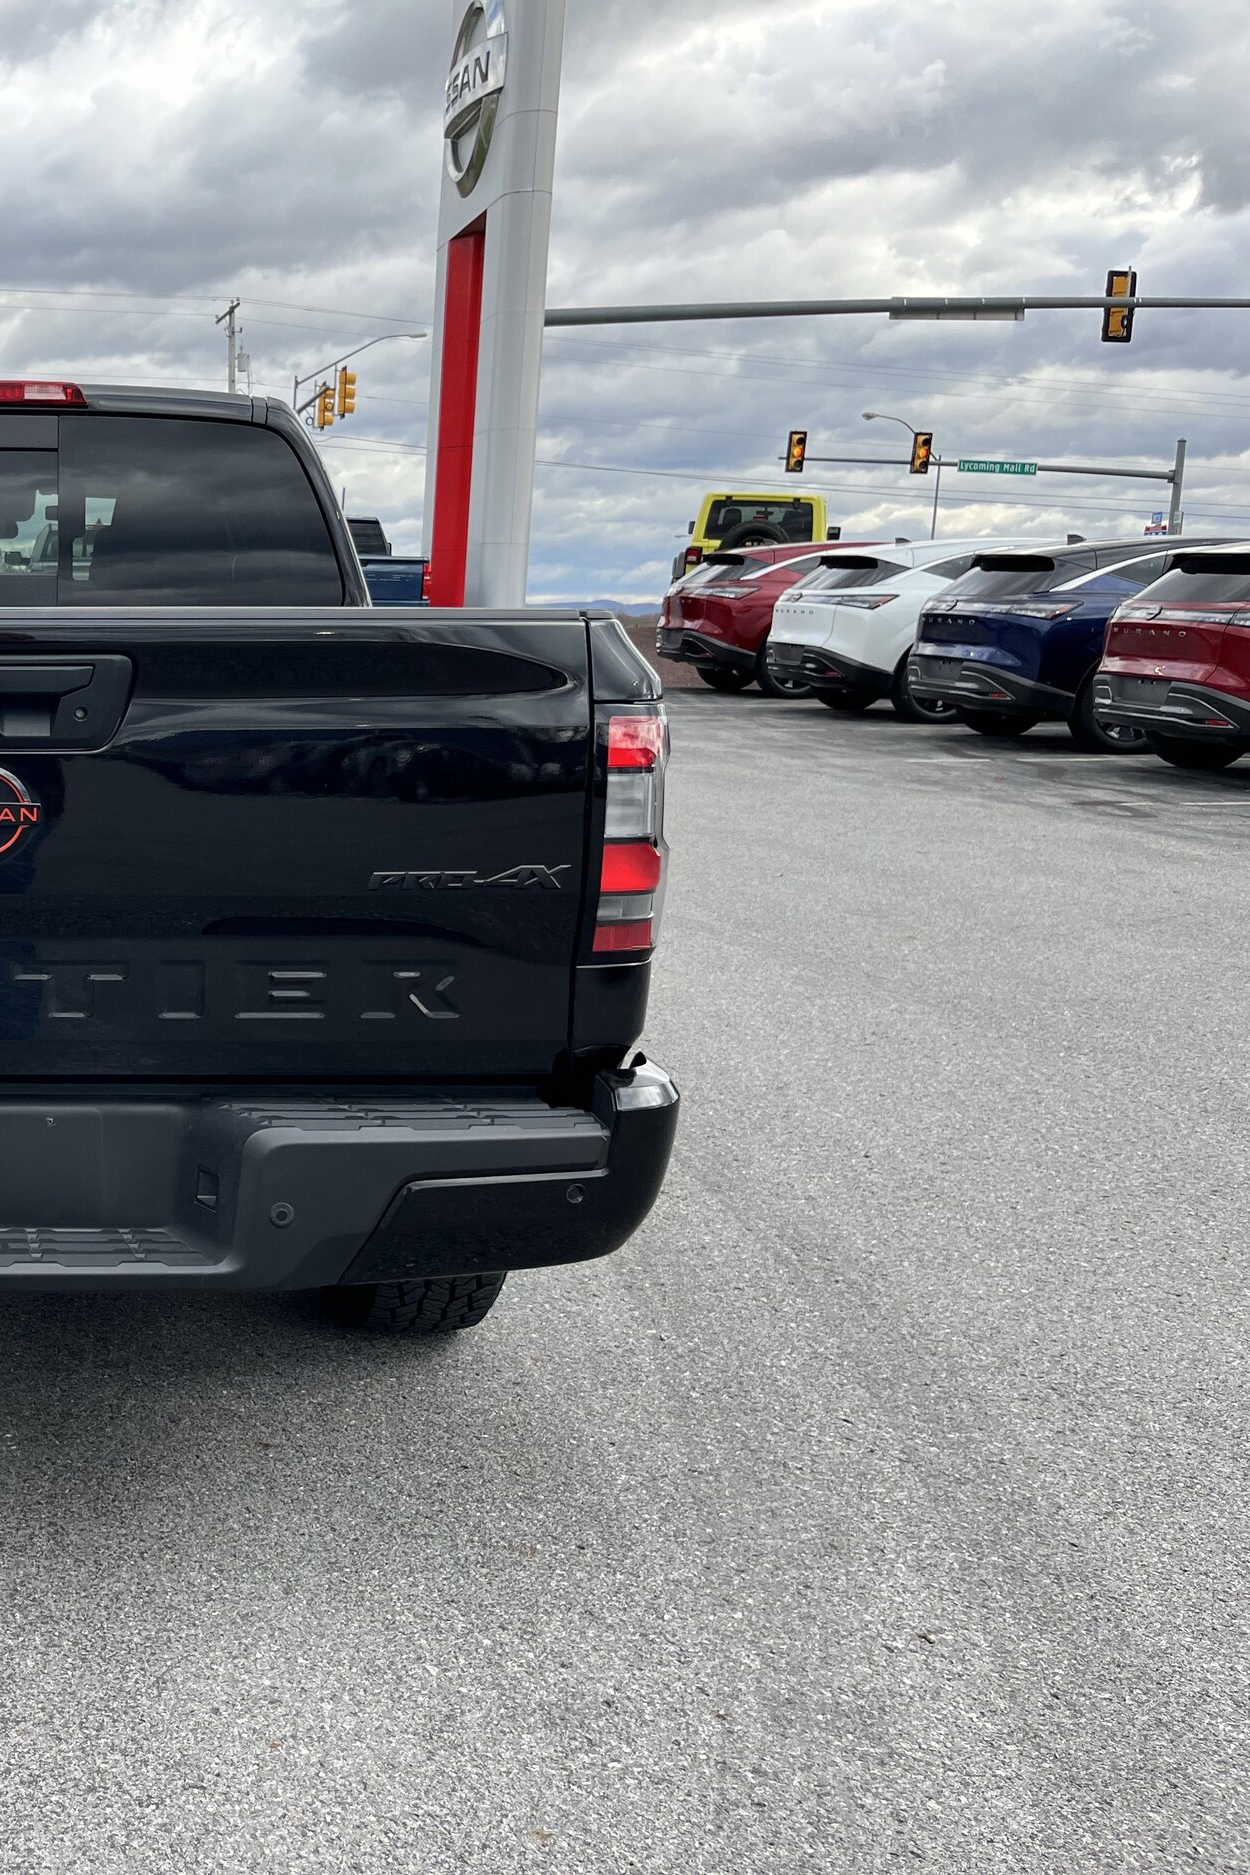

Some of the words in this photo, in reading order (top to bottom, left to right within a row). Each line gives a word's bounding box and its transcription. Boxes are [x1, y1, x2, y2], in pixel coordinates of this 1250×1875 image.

[446, 51, 490, 114] SSAN
[960, 461, 1000, 473] Lycoming
[1003, 463, 1021, 473] Mall
[1024, 464, 1035, 473] Rd
[367, 864, 572, 891] PRO-4X
